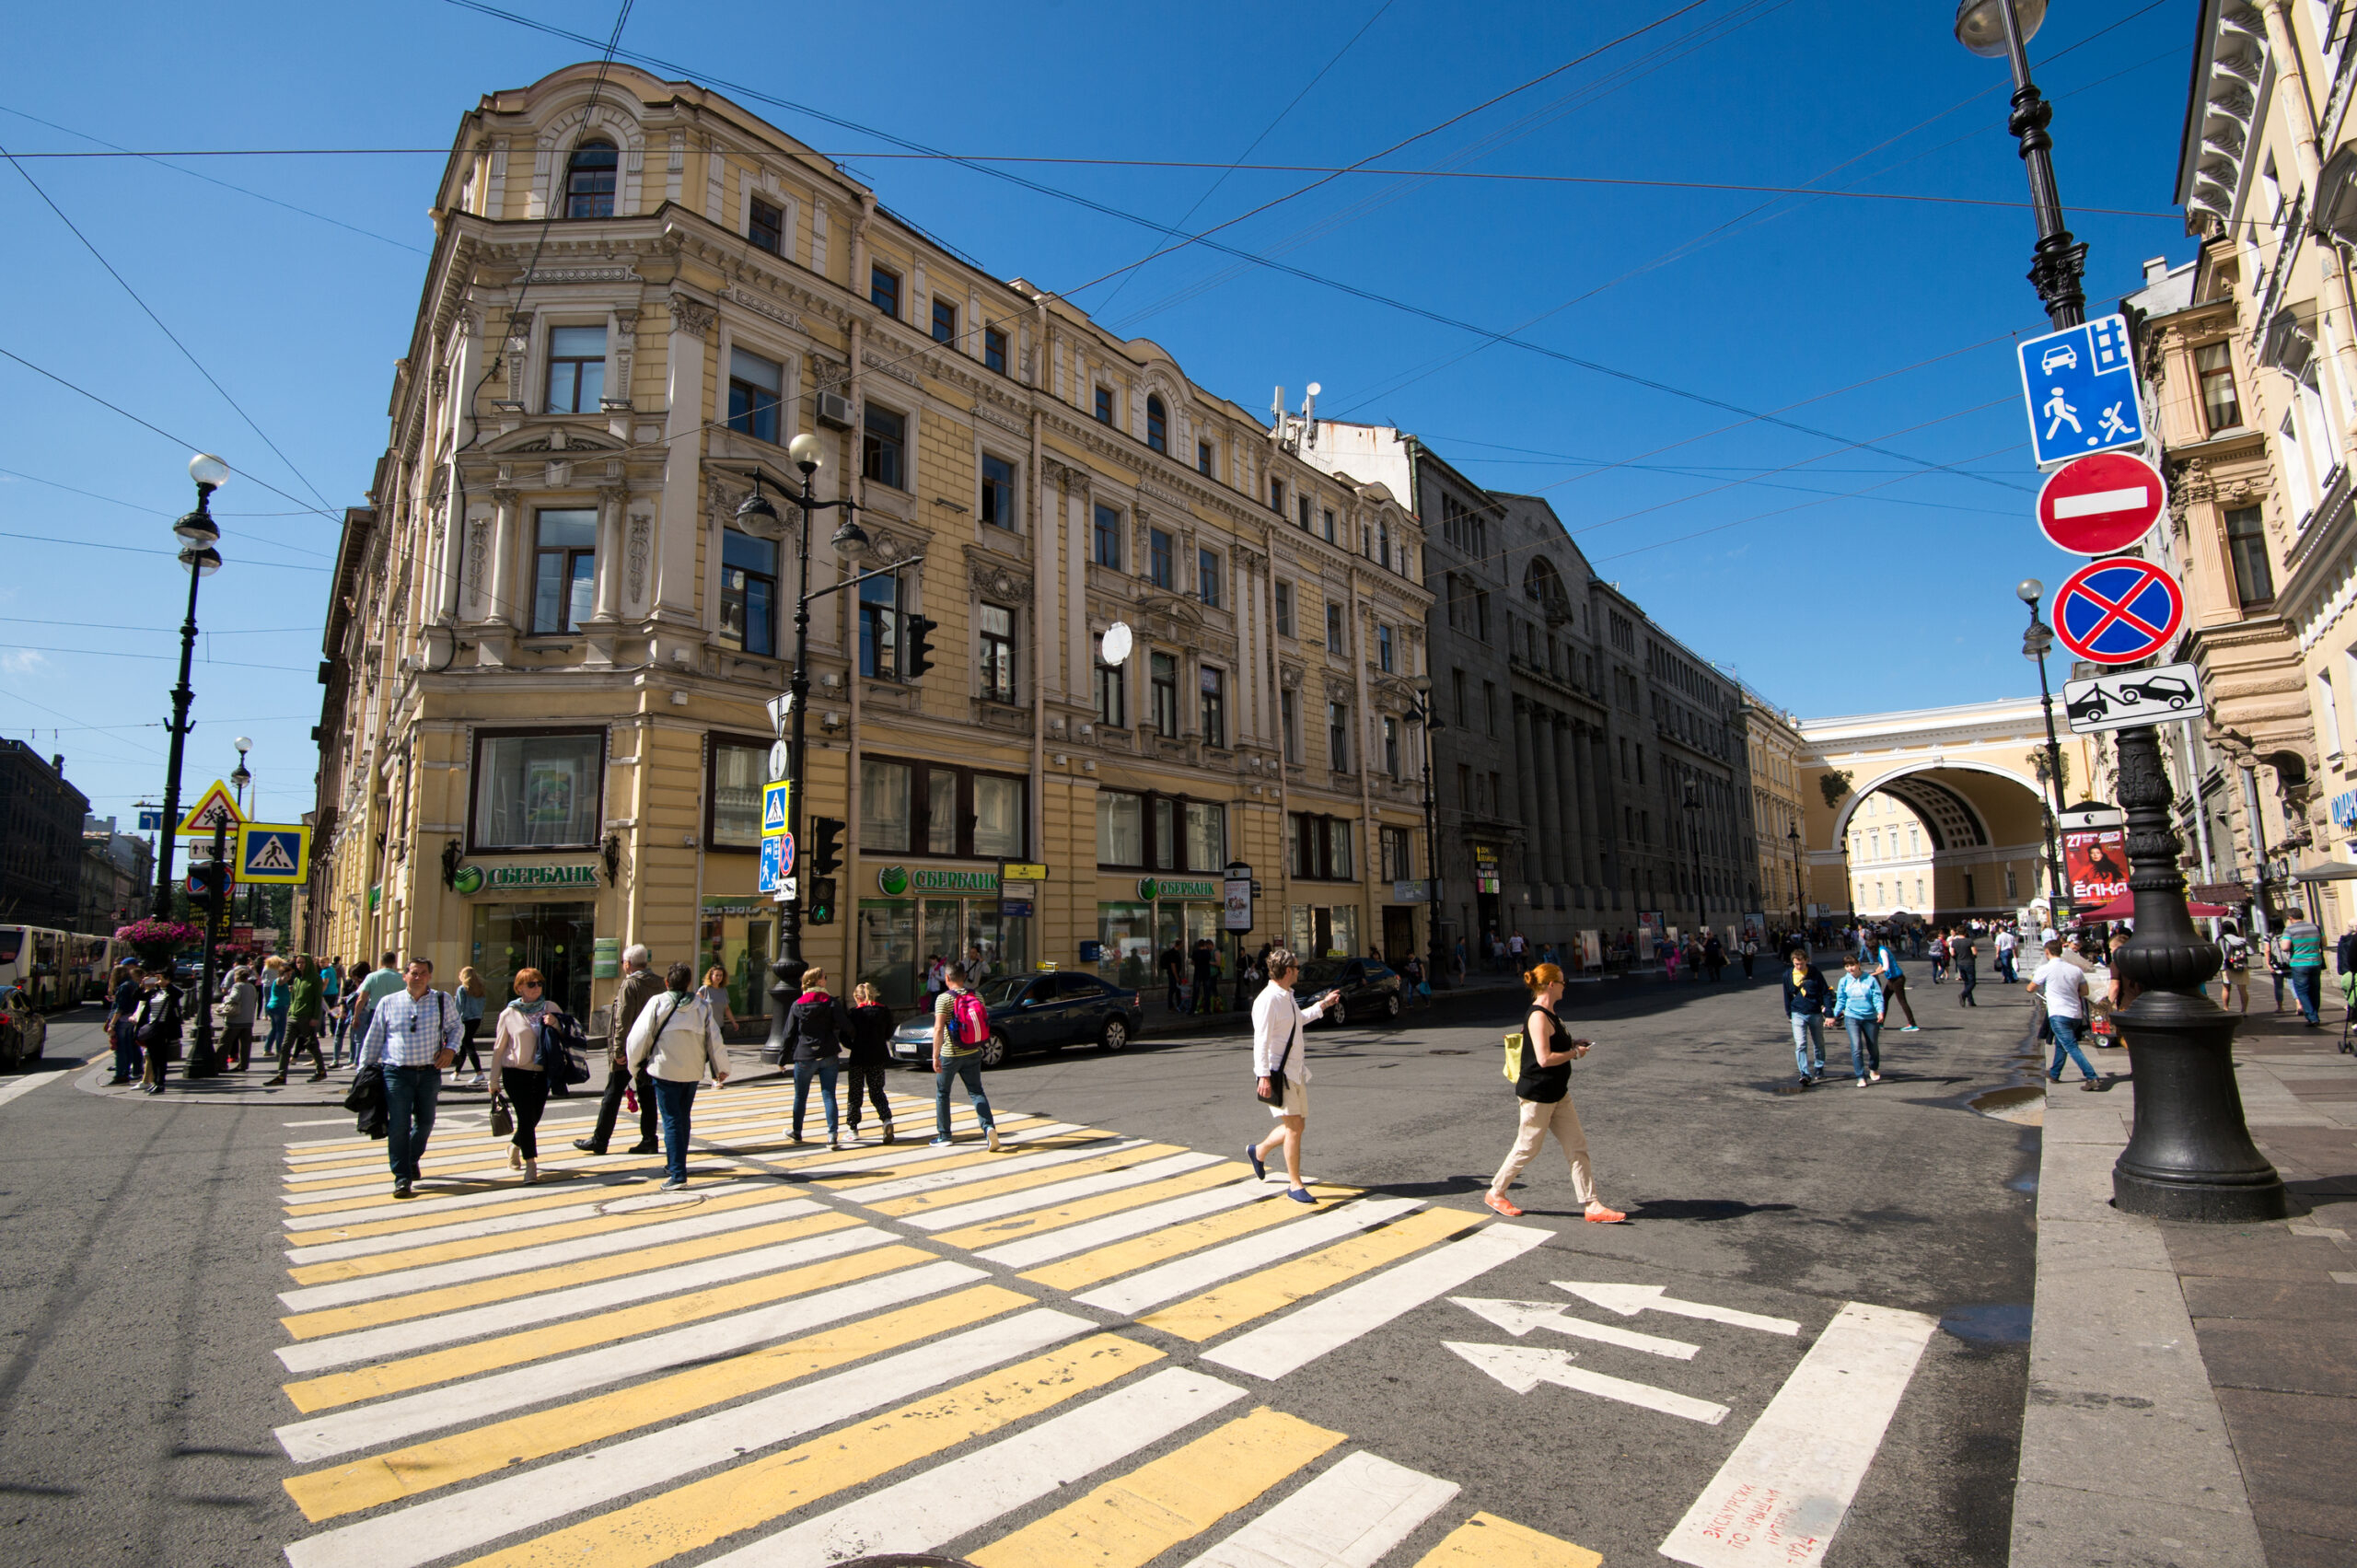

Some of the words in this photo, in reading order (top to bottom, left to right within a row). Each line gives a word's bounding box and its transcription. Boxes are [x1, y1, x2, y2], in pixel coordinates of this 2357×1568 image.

[2066, 834, 2081, 847] 27
[488, 865, 599, 885] СБЕРБАНК
[913, 870, 998, 889] СБЕРБАНК
[1159, 881, 1215, 895] СБЕРБАНК
[222, 915, 230, 927] 5
[1702, 1483, 1756, 1539] ЭКСКУРСИИ
[1727, 1532, 1751, 1551] ПО
[1742, 1488, 1782, 1530] КРЫШАМ
